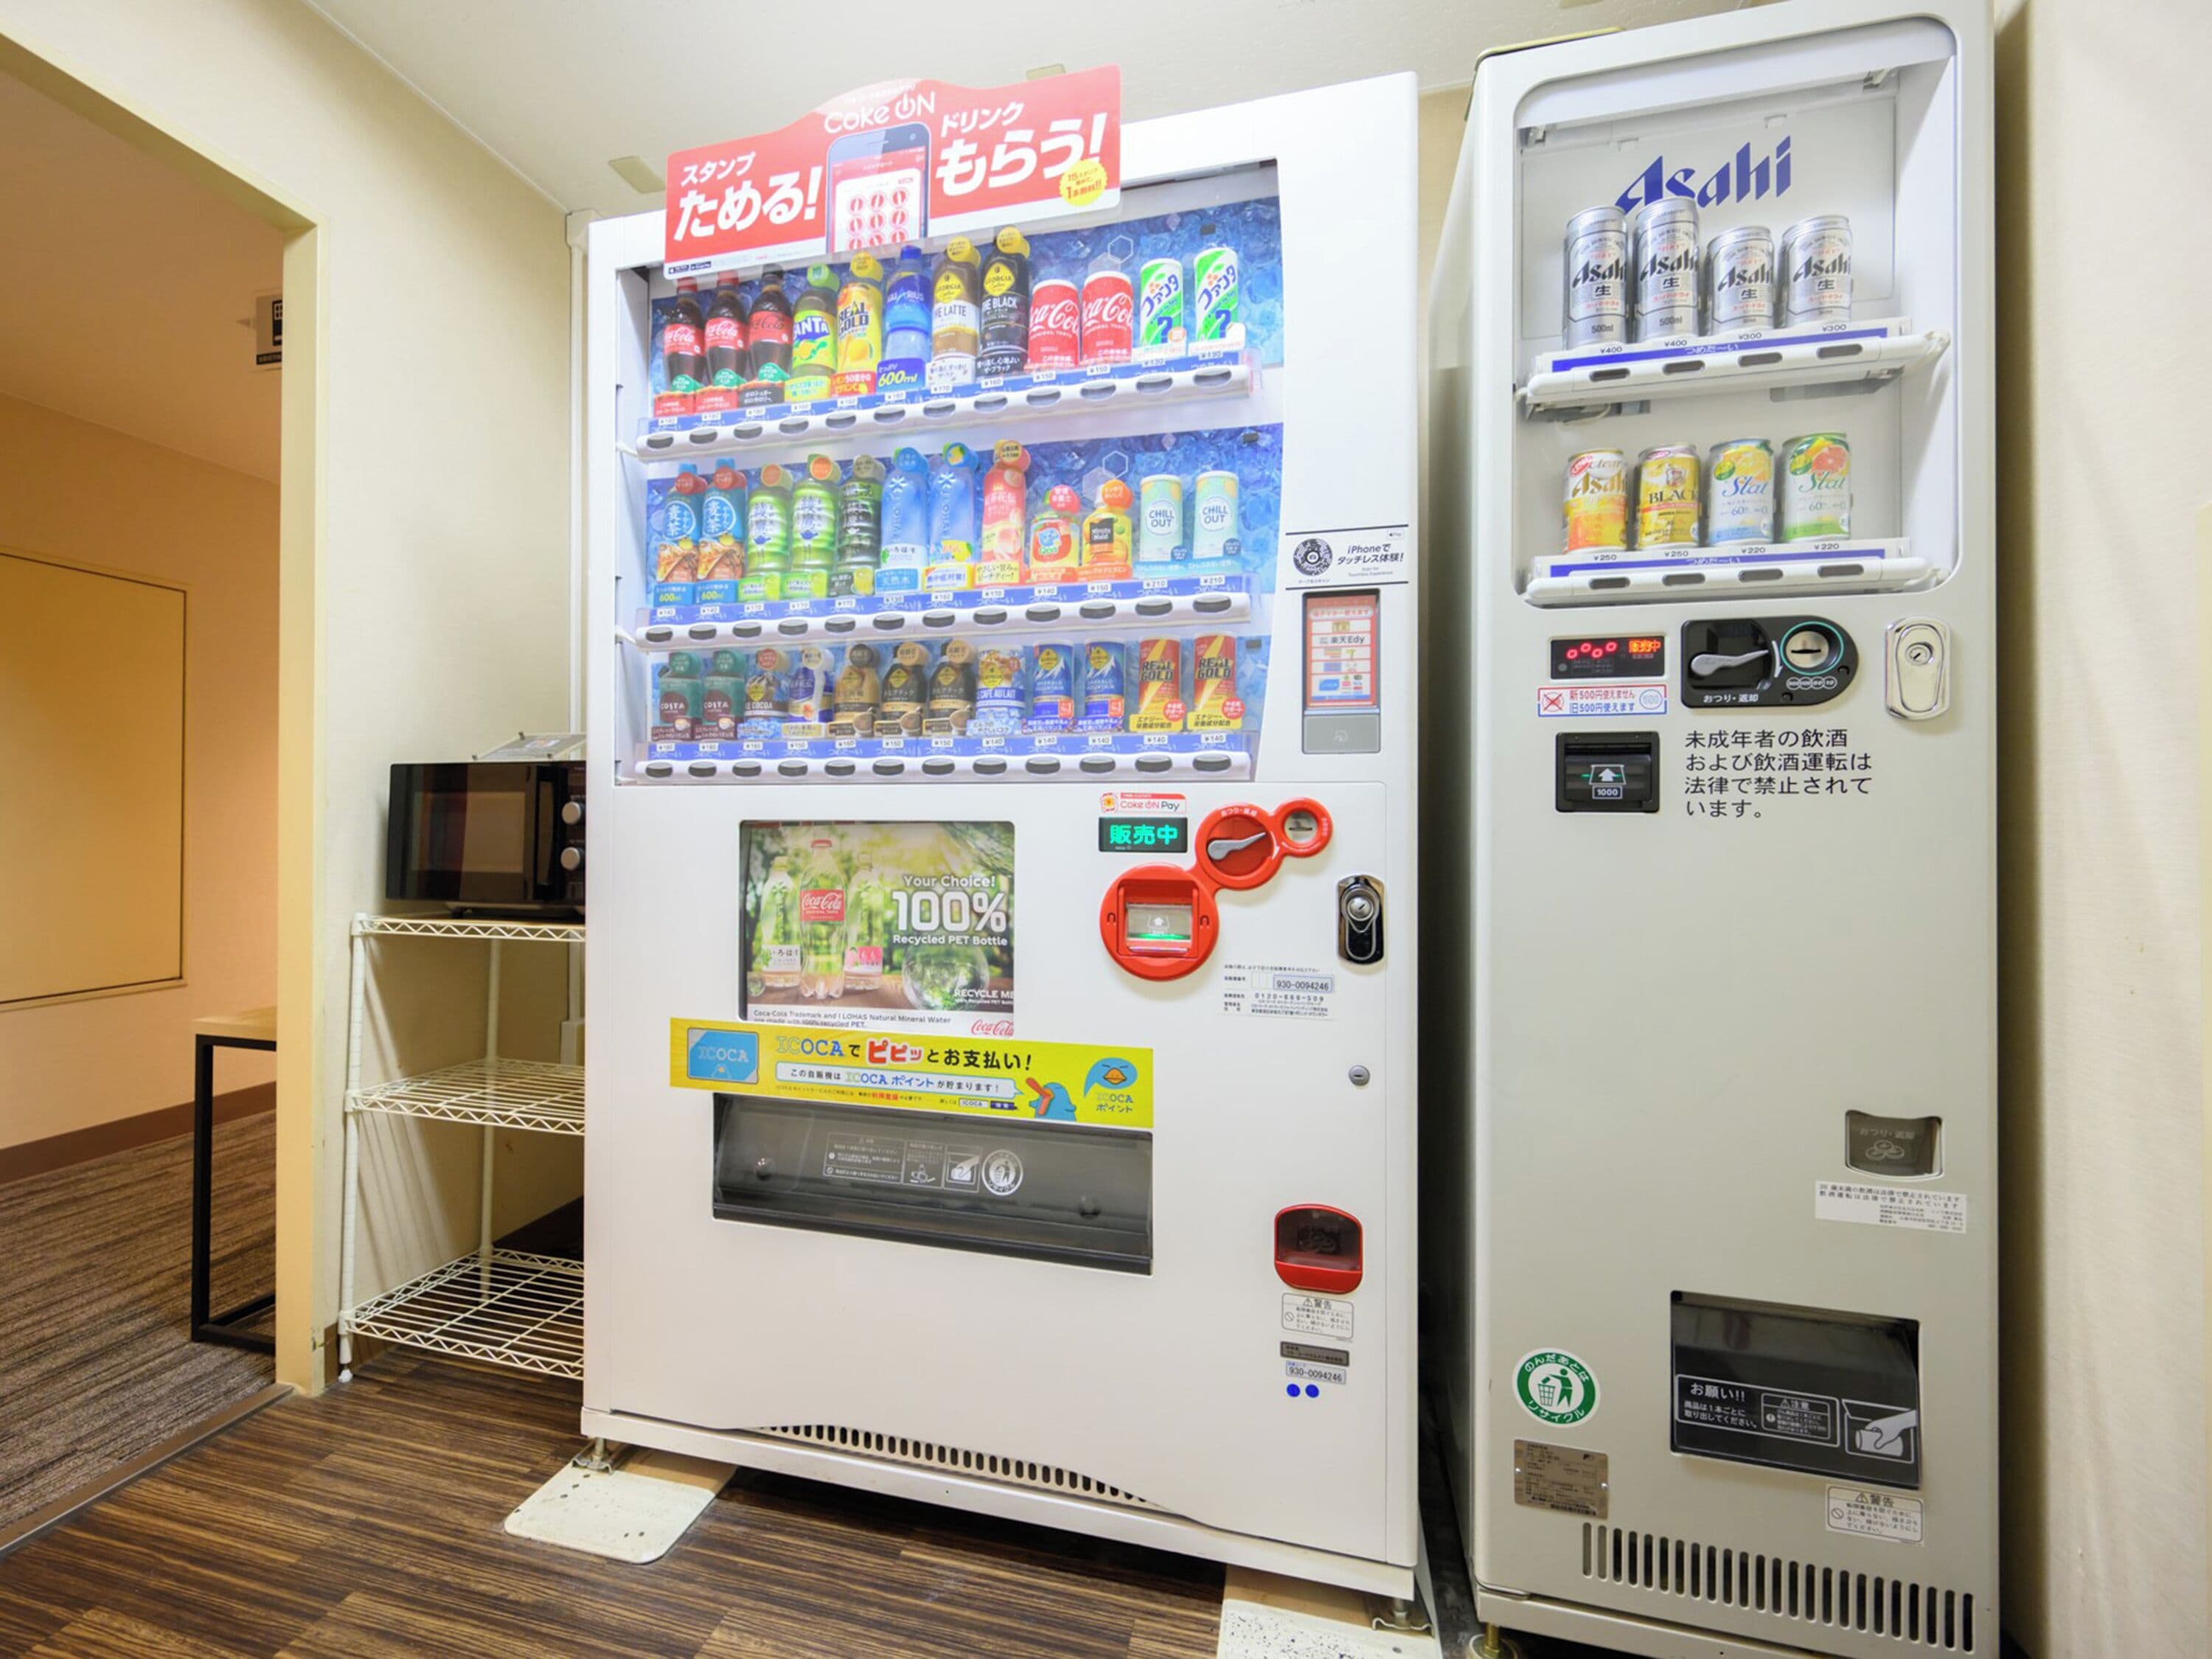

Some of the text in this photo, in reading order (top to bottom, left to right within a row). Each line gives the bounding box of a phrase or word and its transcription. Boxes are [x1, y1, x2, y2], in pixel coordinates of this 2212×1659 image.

[941, 103, 1025, 137] ドリンク
[681, 152, 755, 187] スタンプ
[1615, 136, 1791, 215] Asahi
[1198, 265, 1237, 310] ファンタ
[1663, 277, 1680, 289] 生
[1818, 279, 1834, 291] 生
[1143, 274, 1180, 317] ファンタ
[1595, 285, 1611, 296] 生
[1741, 289, 1758, 300] 生
[993, 297, 1018, 308] BLACK
[944, 305, 967, 317] LATTE
[1660, 316, 1683, 326] 500ml
[1592, 324, 1614, 333] 500ml
[878, 371, 918, 386] 600ml
[1149, 509, 1175, 519] CHILL
[1202, 506, 1228, 515] CHILL
[1151, 518, 1174, 528] OUT
[1203, 514, 1225, 524] OUT
[1348, 543, 1391, 554] iPhoneで
[1142, 659, 1174, 670] REAL
[1199, 656, 1229, 668] REAL
[1141, 669, 1174, 681] GOLD
[1197, 667, 1231, 678] GOLD
[1569, 689, 1635, 700] 新500円使えません
[1570, 703, 1635, 714] 旧500円使えます
[1686, 728, 1848, 748] 未成年者の飲酒
[1686, 752, 1873, 772] および飲酒運転は
[1597, 787, 1618, 796] 1000
[1686, 776, 1871, 795] 法律で禁止されて
[1121, 799, 1180, 811] Coke ON Pay
[1686, 800, 1763, 818] います。
[1110, 824, 1178, 845] 販売中
[903, 875, 996, 888] Your Choice!
[801, 891, 842, 910] Coca-Cola
[892, 890, 1007, 933] 100%
[893, 935, 1007, 946] Recycled PET Bottle
[1276, 980, 1329, 991] 930-0094246
[698, 1046, 749, 1063] ICOCA
[1096, 1092, 1133, 1104] ICOCA
[1096, 1103, 1133, 1114] ポイント
[1289, 1366, 1342, 1382] 930-0094246
[1691, 1382, 1745, 1402] お願い!!
[1527, 1400, 1585, 1423] リサイクル
